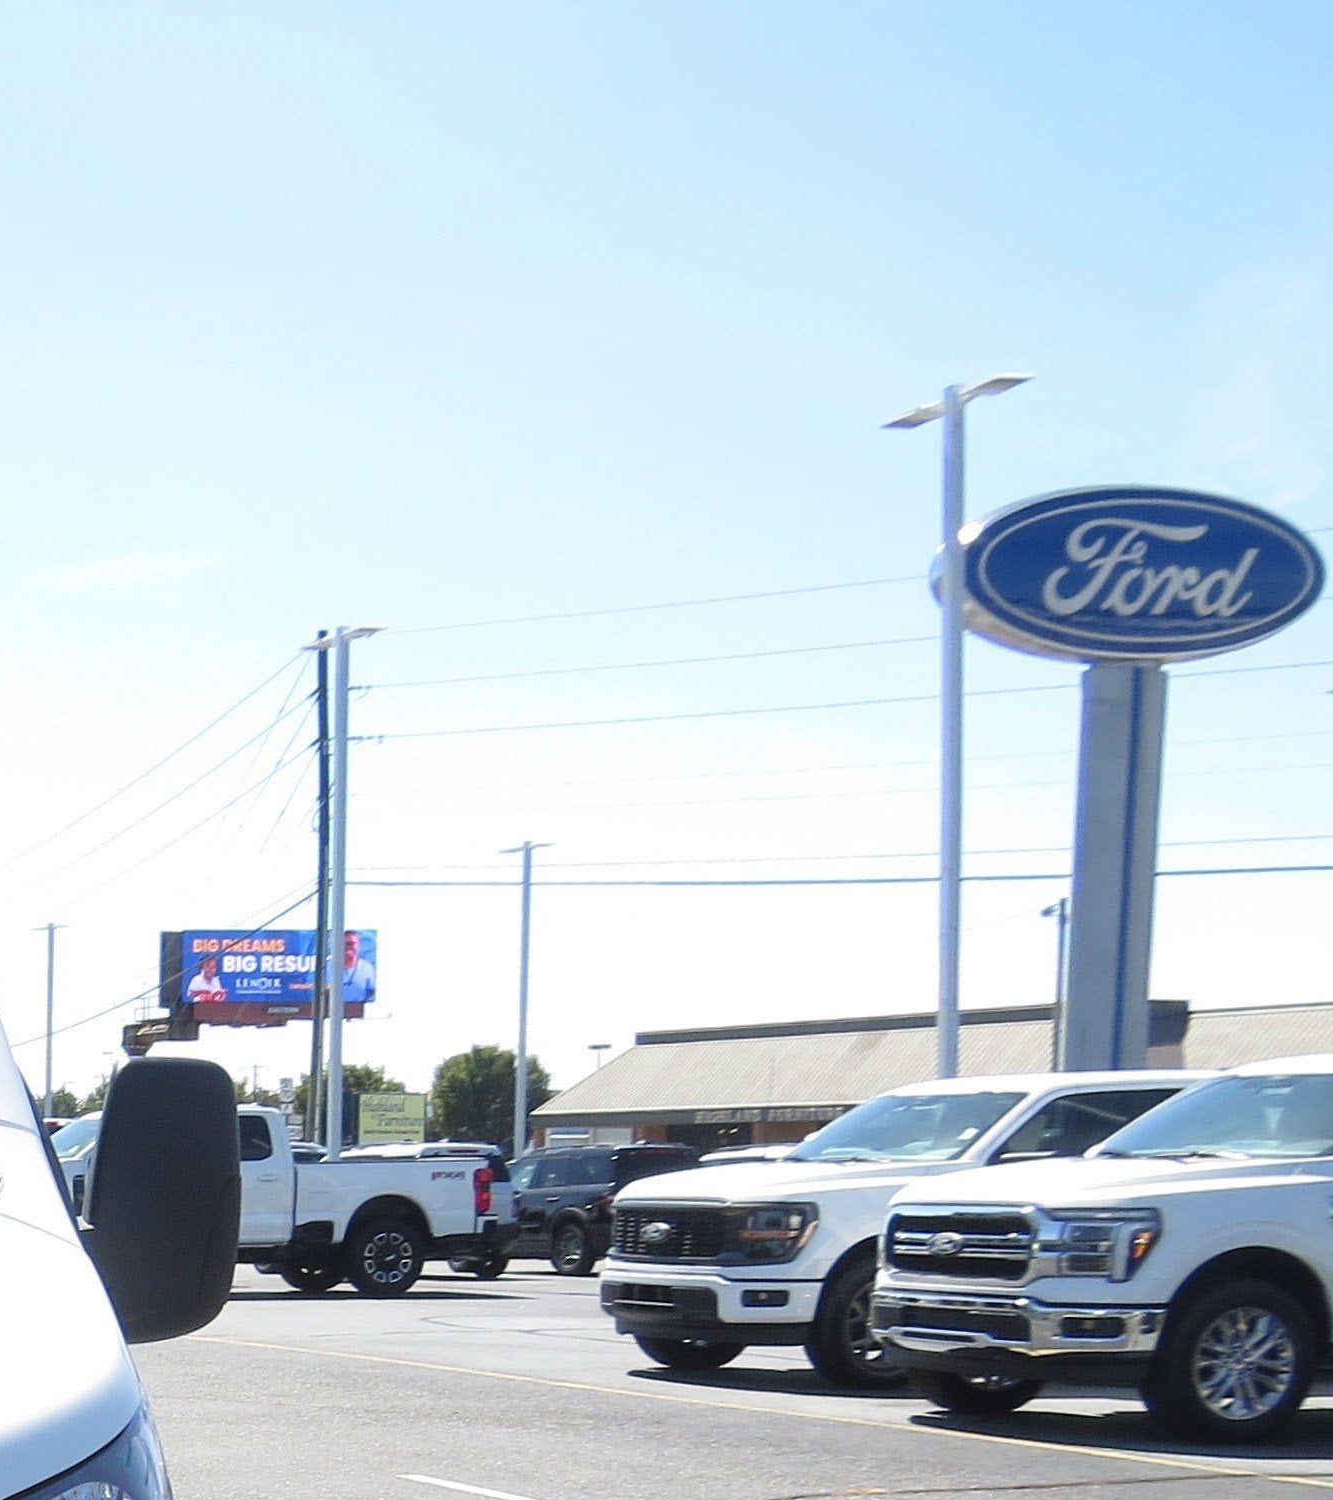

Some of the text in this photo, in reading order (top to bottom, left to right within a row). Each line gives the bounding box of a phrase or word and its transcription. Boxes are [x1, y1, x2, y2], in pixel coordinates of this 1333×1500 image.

[1042, 517, 1260, 617] Ford
[193, 938, 285, 953] BIG DREAMS
[222, 954, 258, 973] BIG
